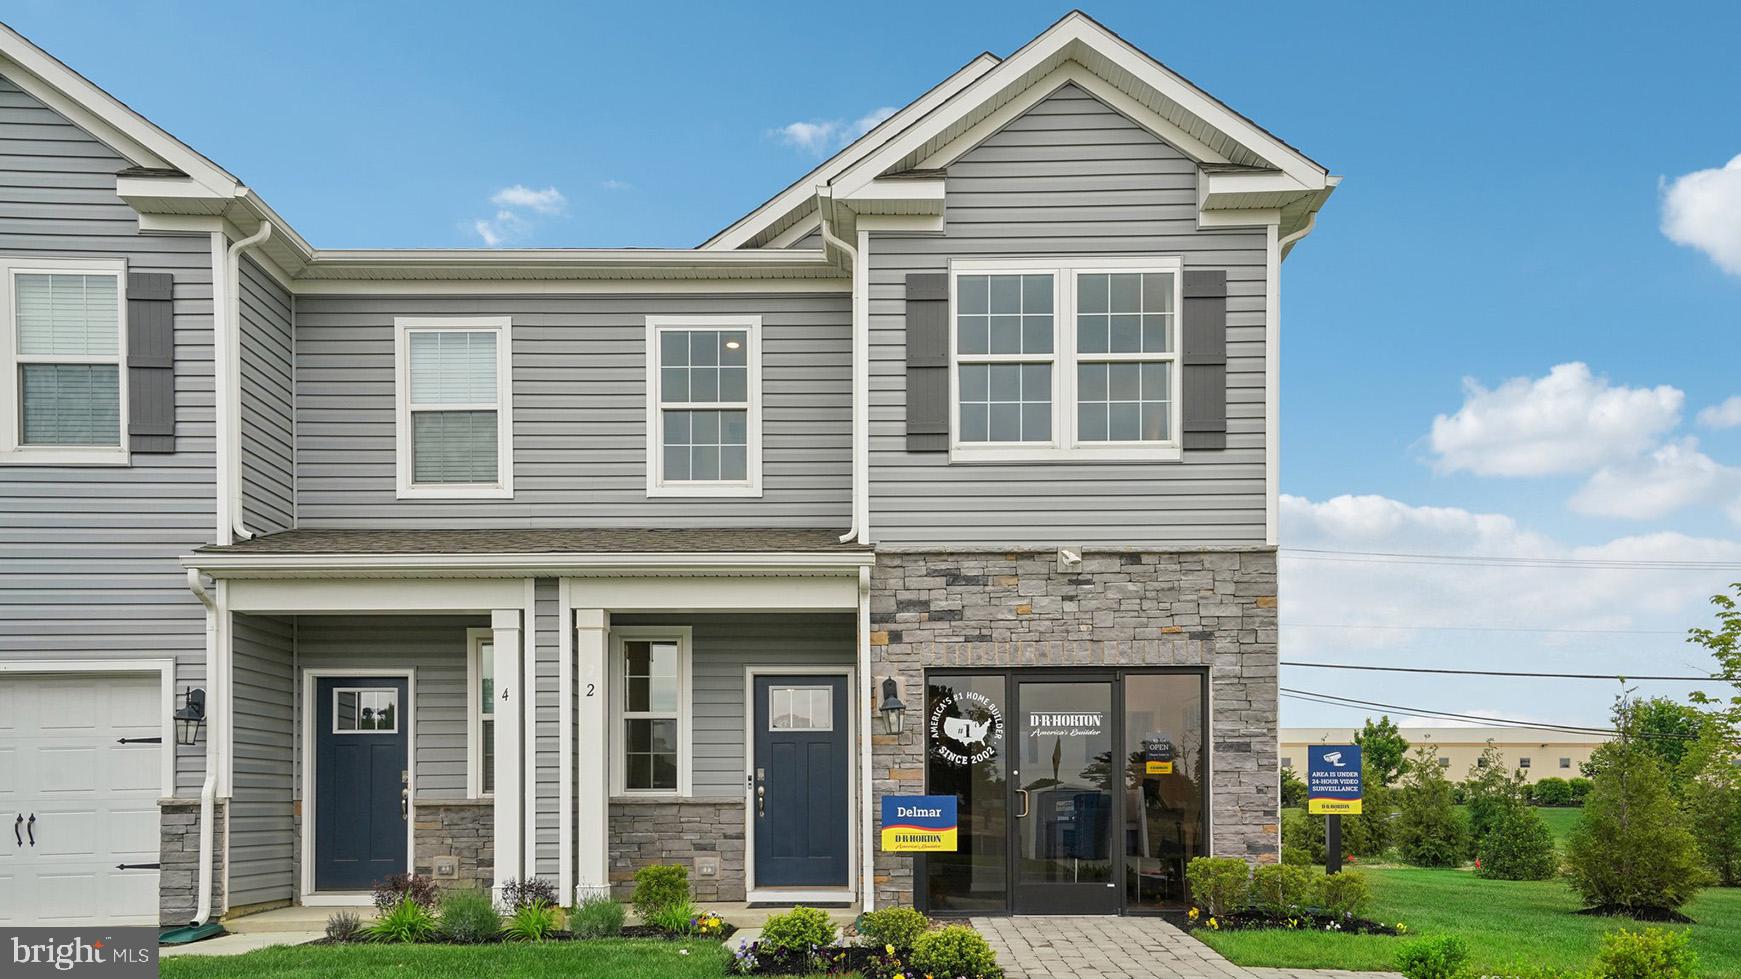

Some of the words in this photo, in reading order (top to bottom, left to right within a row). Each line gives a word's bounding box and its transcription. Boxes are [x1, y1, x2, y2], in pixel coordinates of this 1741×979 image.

[501, 687, 509, 701] 4
[586, 683, 595, 697] 2
[930, 696, 952, 739] AMERICA'S
[953, 692, 964, 702] #1
[966, 691, 990, 706] HOME
[988, 703, 1004, 740] BUILDER
[1030, 728, 1068, 737] America's
[1070, 728, 1101, 737] Builder
[1149, 743, 1169, 751] OPEN
[938, 745, 968, 765] SINCE
[970, 746, 995, 765] 2002
[896, 806, 942, 818] Delmar
